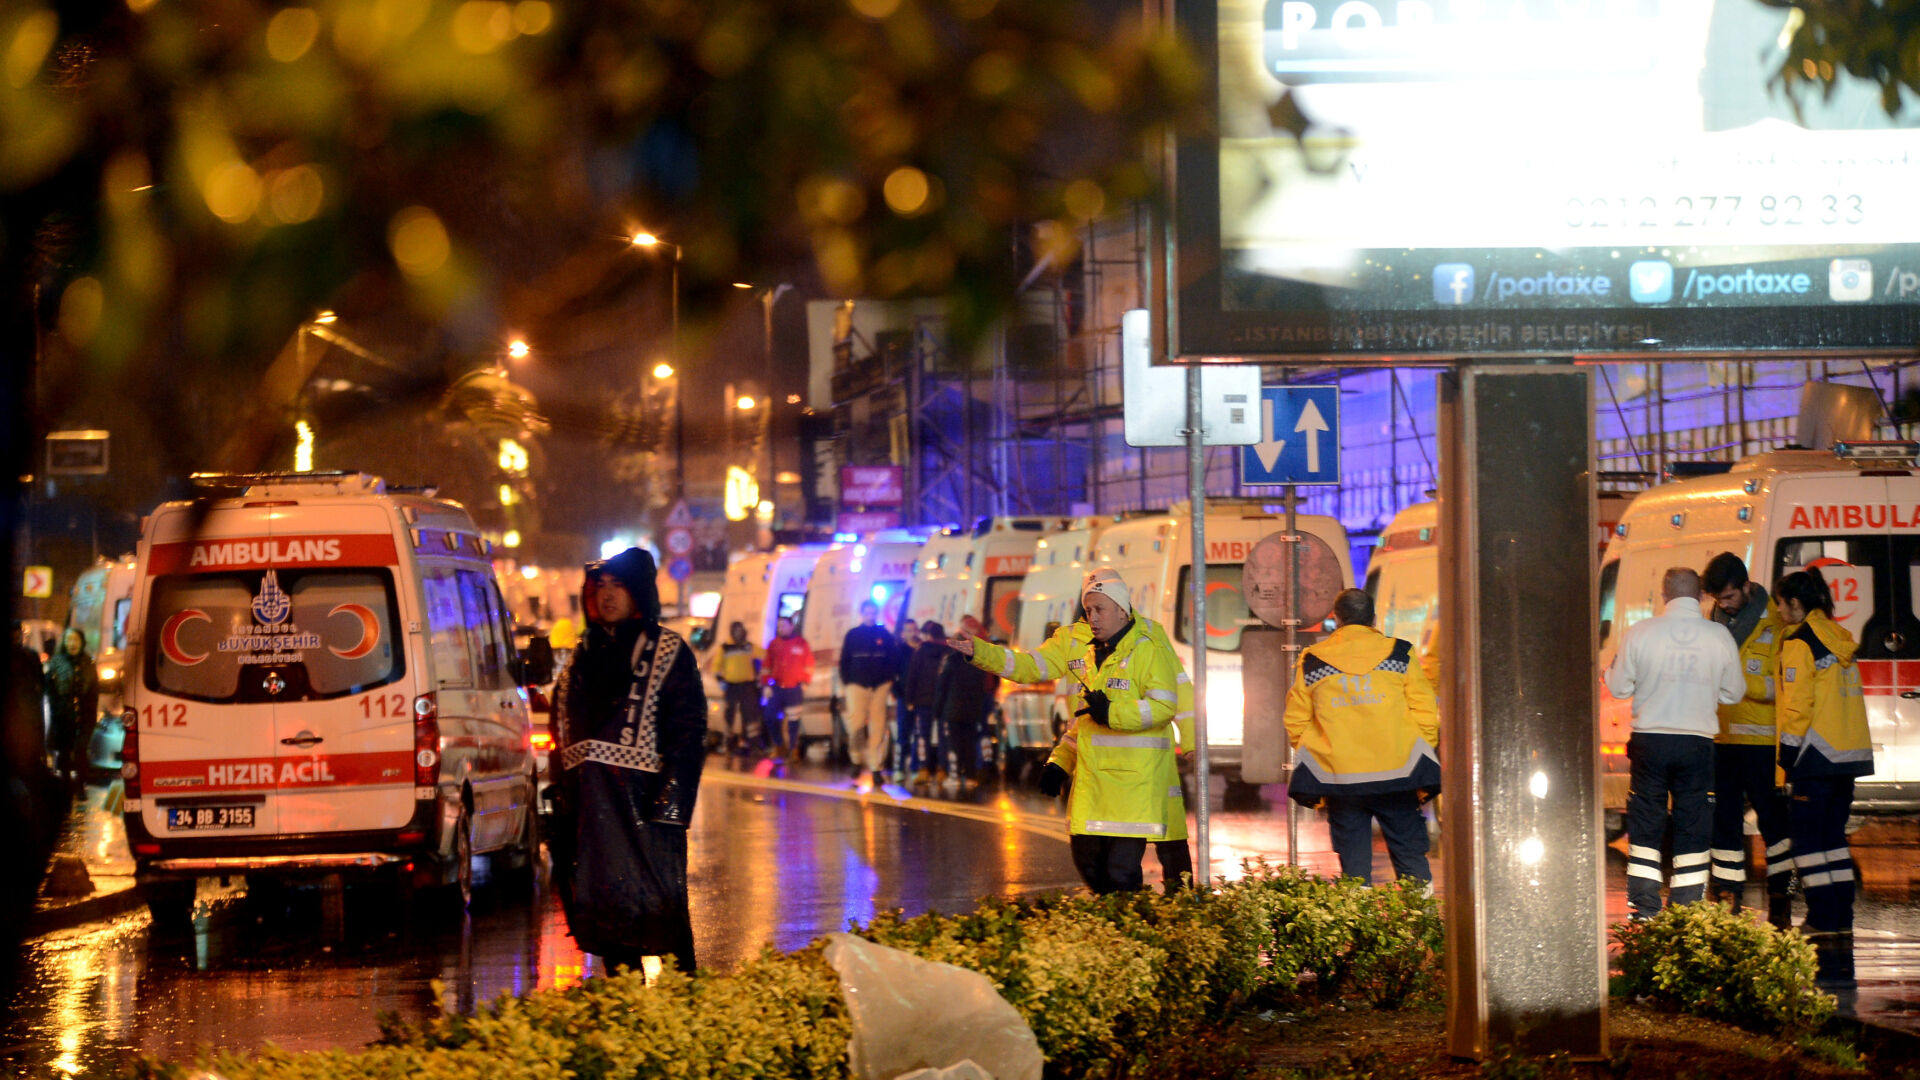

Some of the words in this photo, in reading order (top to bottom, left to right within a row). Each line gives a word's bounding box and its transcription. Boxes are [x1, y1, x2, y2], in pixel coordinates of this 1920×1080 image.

[1566, 196, 1657, 228] 0212
[1674, 196, 1742, 227] 277
[1760, 195, 1803, 226] 82
[1821, 194, 1864, 225] 33
[1484, 271, 1612, 301] /portaxe
[1683, 268, 1811, 299] /portaxe
[1884, 265, 1920, 298] /p
[190, 539, 342, 567] AMBULANS
[1338, 673, 1373, 693] 112
[142, 703, 188, 728] 112
[358, 693, 407, 719] 112
[208, 762, 276, 786] HIZIR
[279, 753, 336, 783] ACİL
[176, 810, 193, 826] 34
[196, 809, 214, 825] BB
[219, 808, 252, 824] 3155
